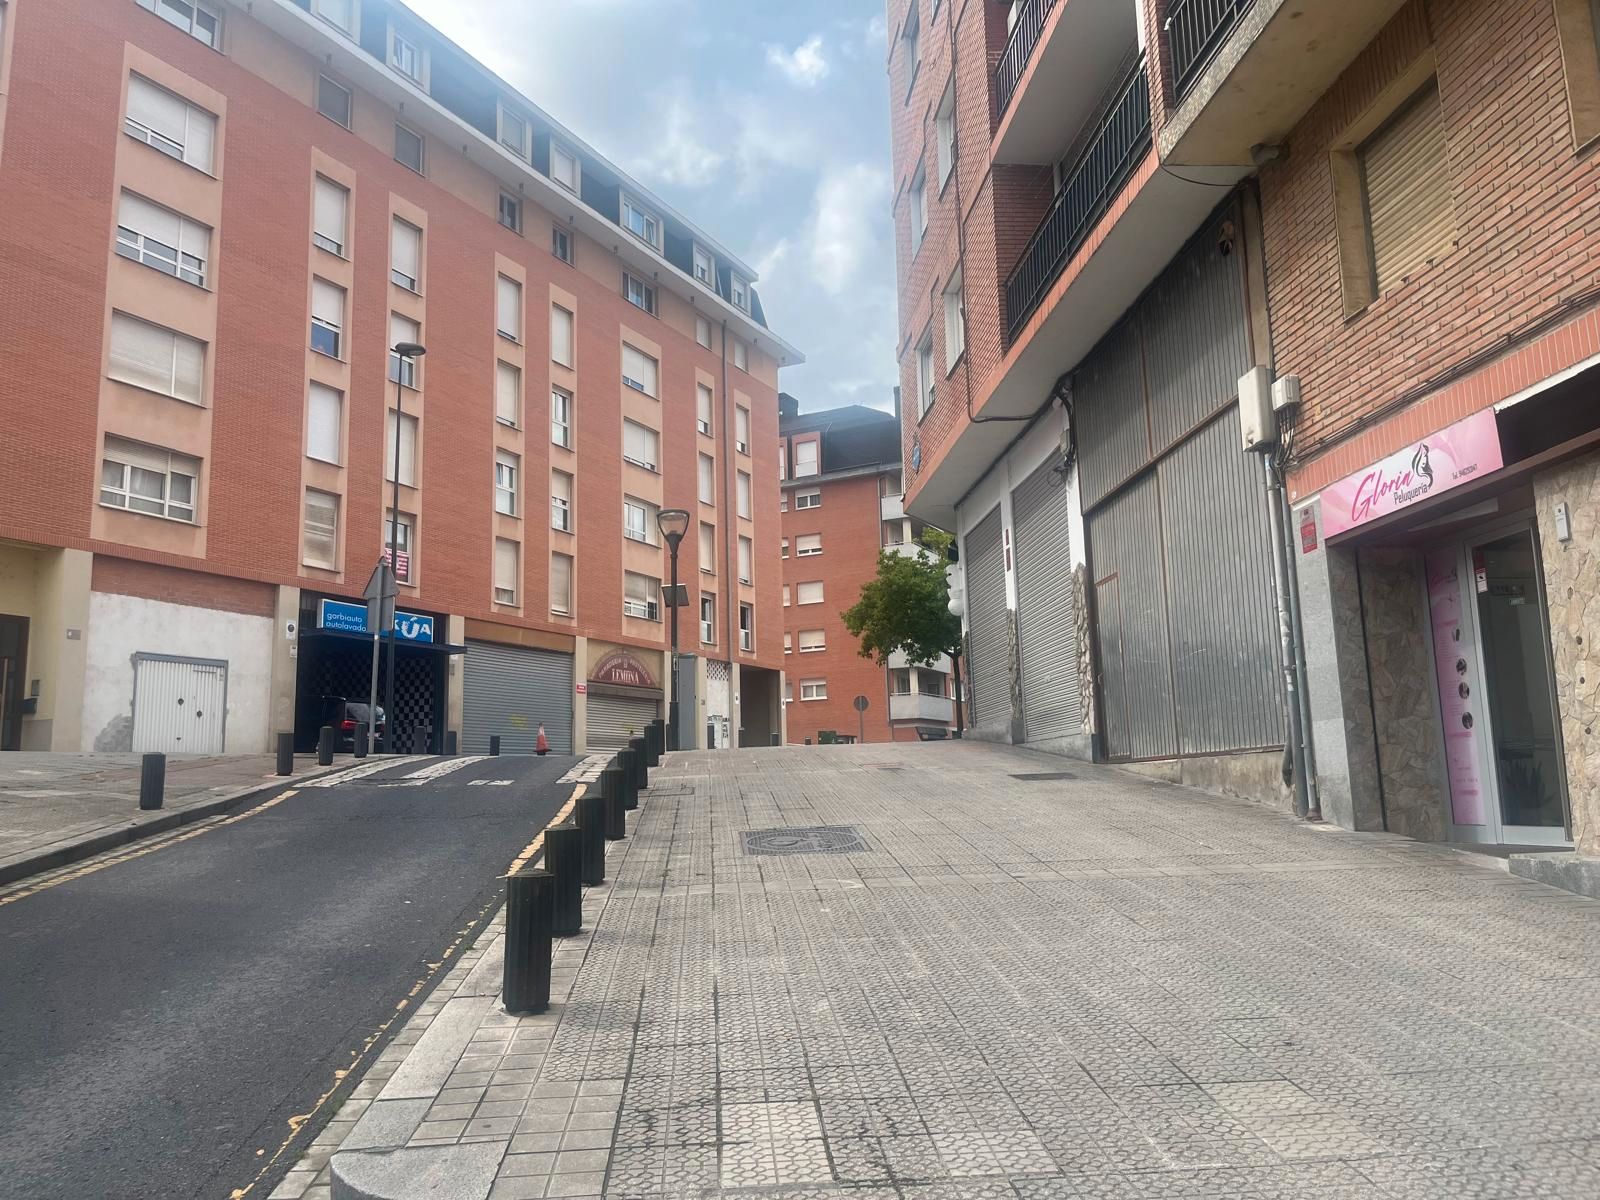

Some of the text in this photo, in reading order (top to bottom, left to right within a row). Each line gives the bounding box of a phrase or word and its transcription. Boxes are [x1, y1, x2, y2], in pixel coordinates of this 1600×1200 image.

[1352, 469, 1414, 521] Gloria
[1394, 483, 1428, 504] Peluquería
[326, 621, 366, 632] autolavado
